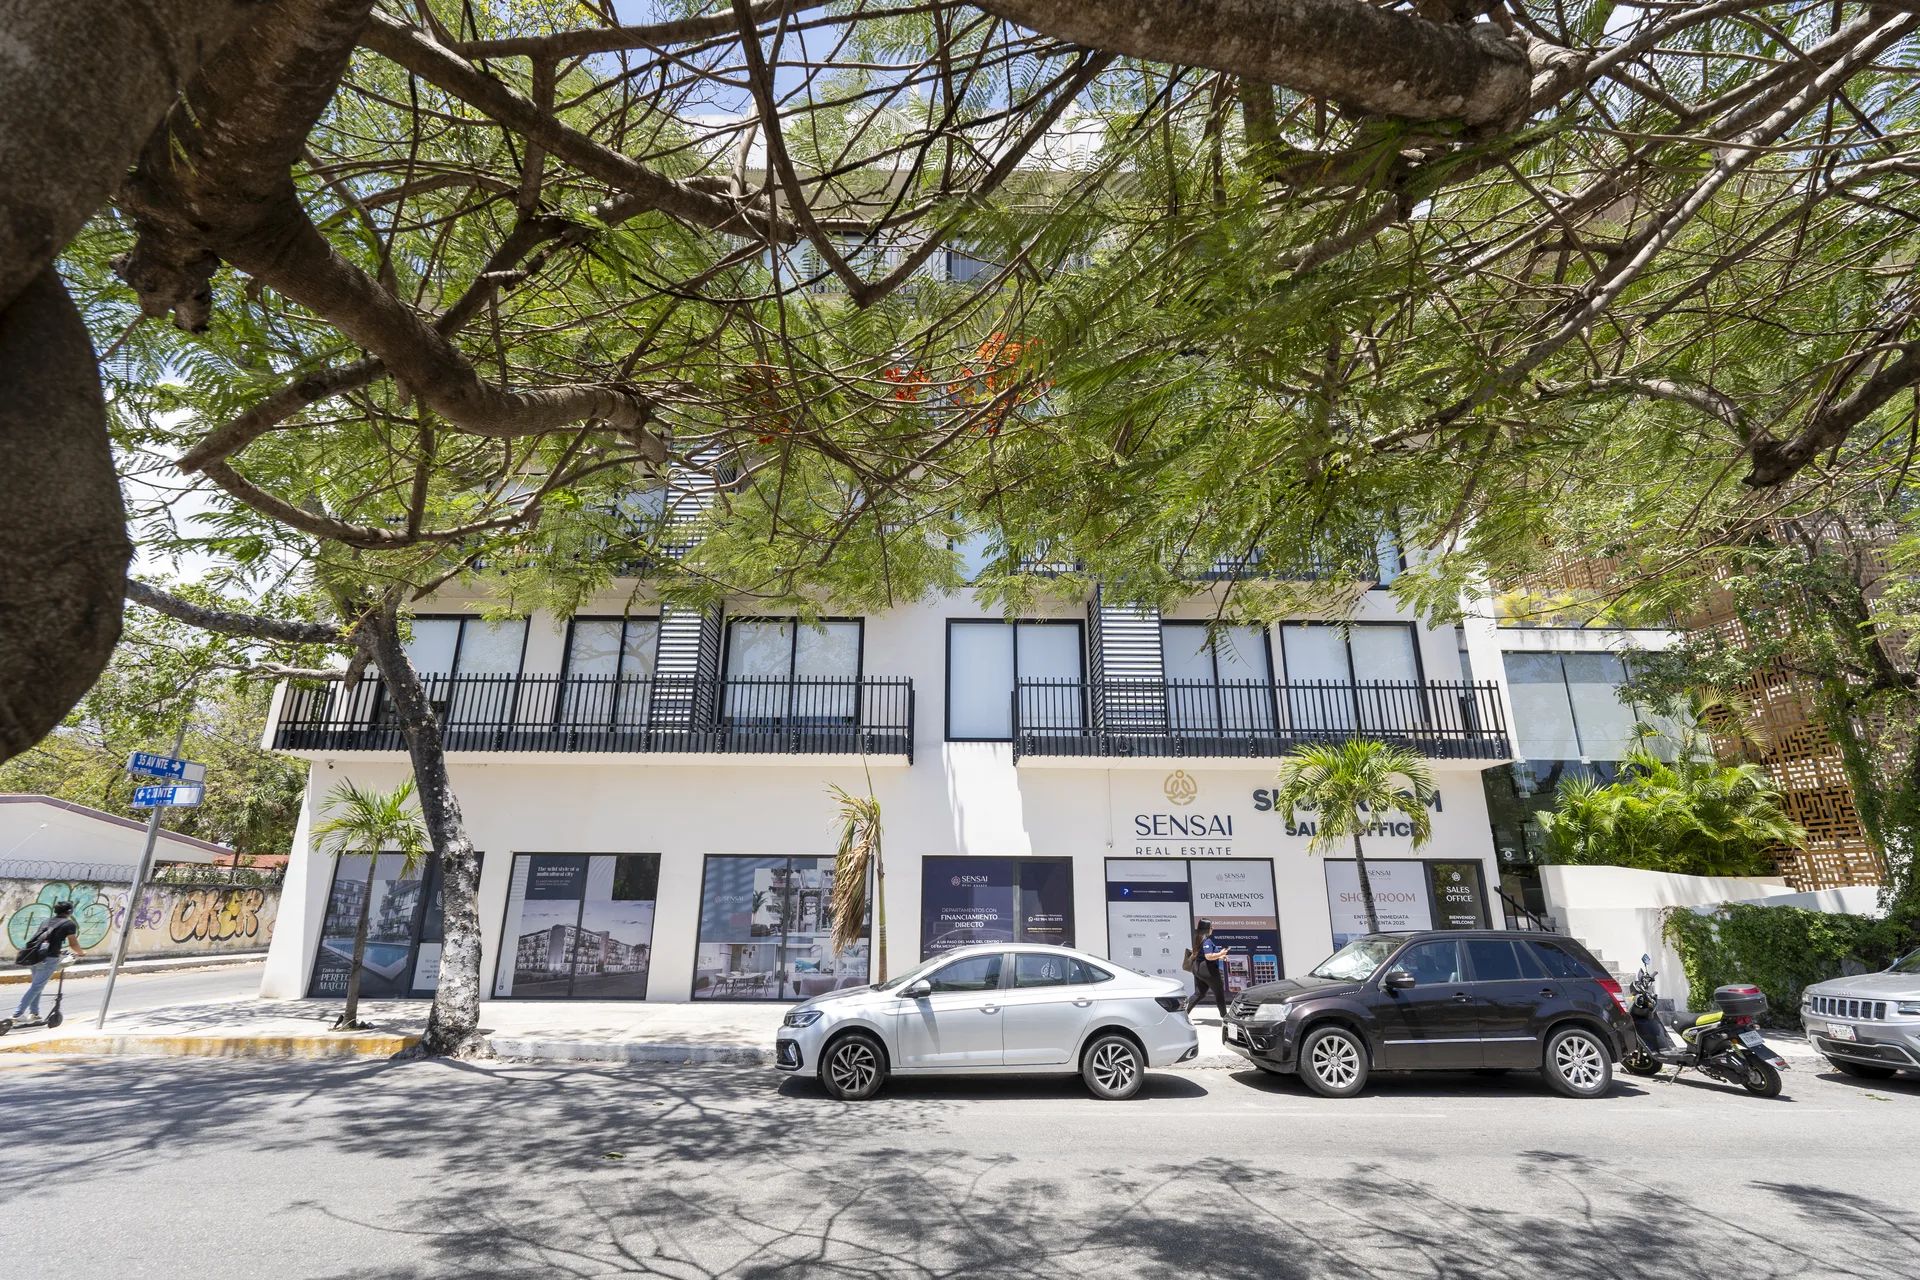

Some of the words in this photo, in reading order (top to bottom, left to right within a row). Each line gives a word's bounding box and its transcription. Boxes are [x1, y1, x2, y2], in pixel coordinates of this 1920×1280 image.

[137, 754, 147, 766] 35
[146, 756, 157, 767] AV
[155, 758, 169, 770] NTE
[157, 787, 173, 798] NTE
[1134, 814, 1233, 836] SENSAI
[1135, 847, 1171, 856] REAL
[1181, 847, 1232, 856] ESTATE
[1446, 886, 1470, 894] SALES
[1340, 892, 1416, 903] SHOROOM
[1446, 894, 1473, 902] OFFICE
[320, 973, 350, 982] PERFEC
[319, 982, 348, 991] MATCH
